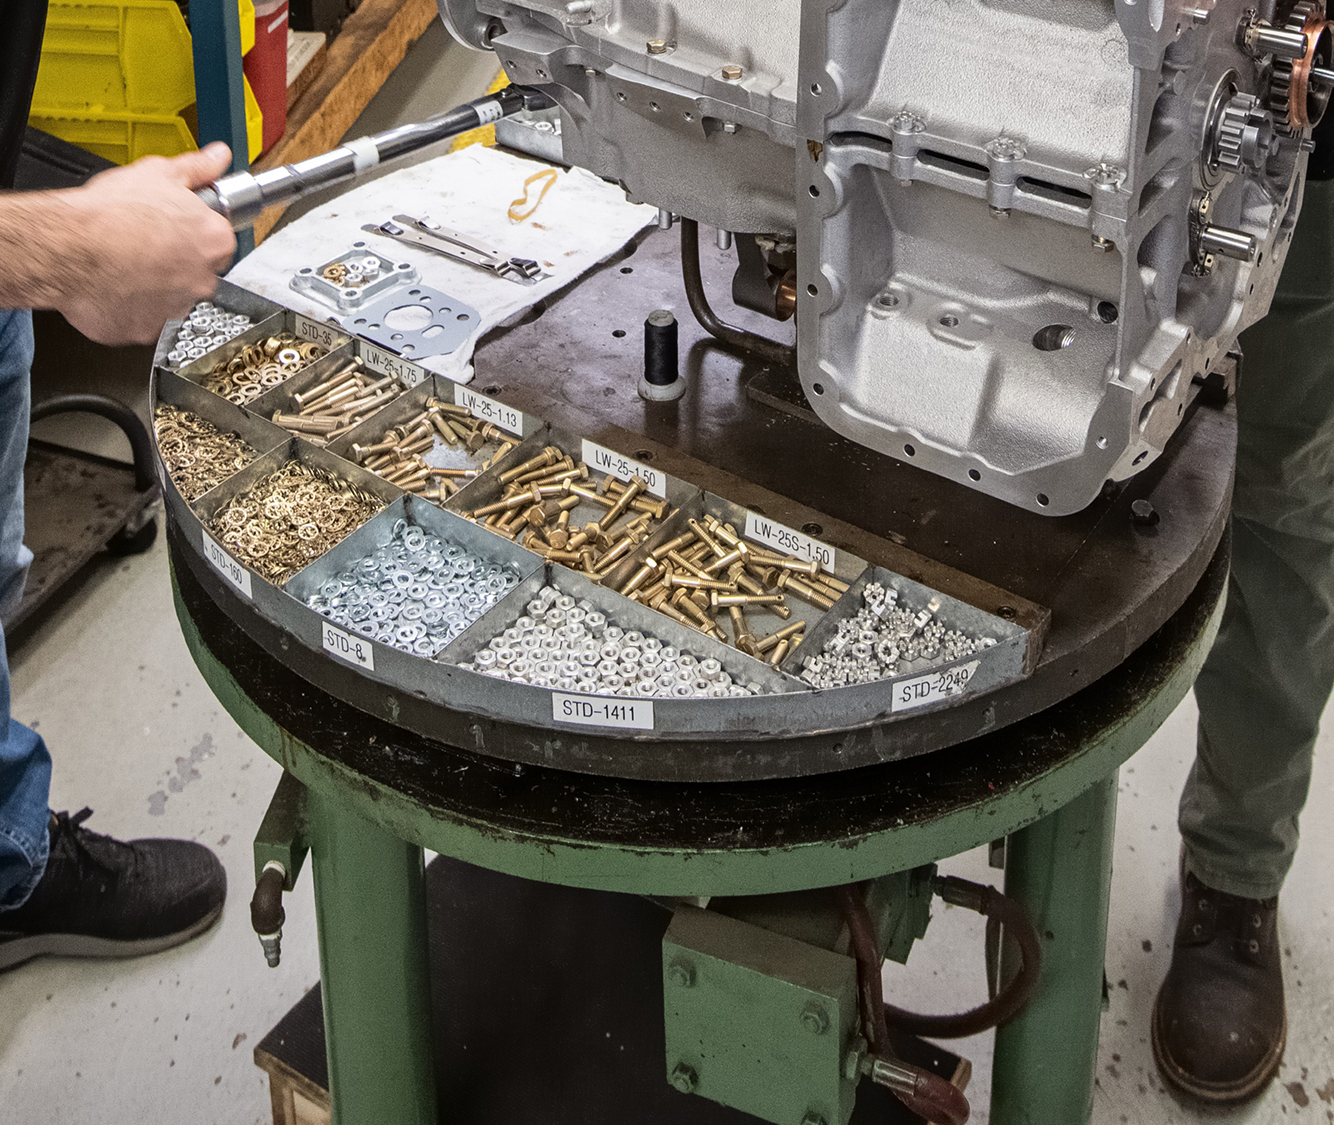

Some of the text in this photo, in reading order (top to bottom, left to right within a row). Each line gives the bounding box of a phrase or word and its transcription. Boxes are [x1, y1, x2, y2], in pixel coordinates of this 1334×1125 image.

[301, 321, 332, 346] STD-35
[366, 349, 417, 383] LW-25-1.75
[462, 391, 517, 427] LW-25-1.13
[595, 449, 656, 488] LW-25-150
[754, 518, 830, 566] LW-25S-1.50
[210, 542, 243, 586] STD-160
[902, 668, 969, 705] STD-2249
[562, 698, 636, 723] STD-1411
